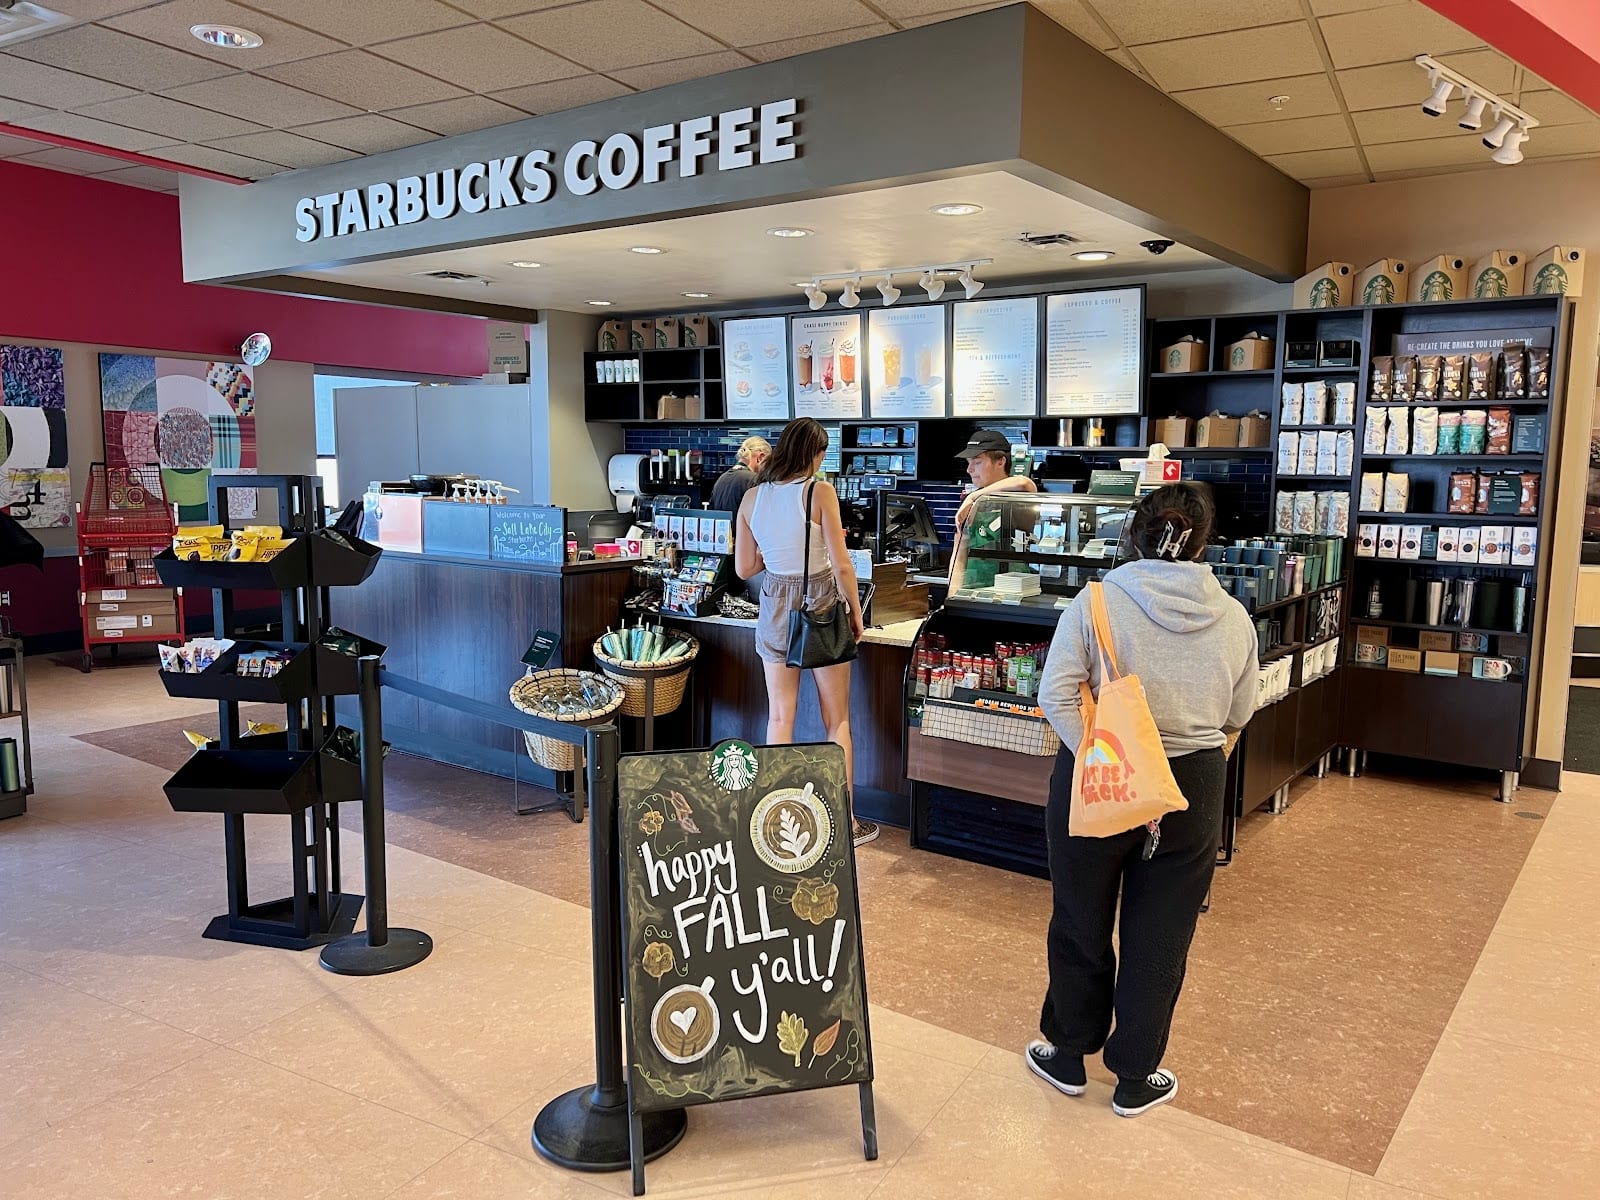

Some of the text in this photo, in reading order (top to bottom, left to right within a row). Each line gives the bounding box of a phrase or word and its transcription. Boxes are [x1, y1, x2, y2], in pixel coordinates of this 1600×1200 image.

[295, 98, 799, 243] STARBUCKS COFFEE
[1407, 342, 1438, 351] RE-CREATE
[1440, 341, 1451, 350] THE
[1452, 339, 1474, 349] DRINKS
[1475, 339, 1488, 349] YOU
[1489, 338, 1504, 348] LOVE
[503, 521, 552, 542] Salt Lake City
[640, 840, 737, 898] happy
[672, 885, 790, 959] FALL
[730, 919, 847, 1043] y'all!
